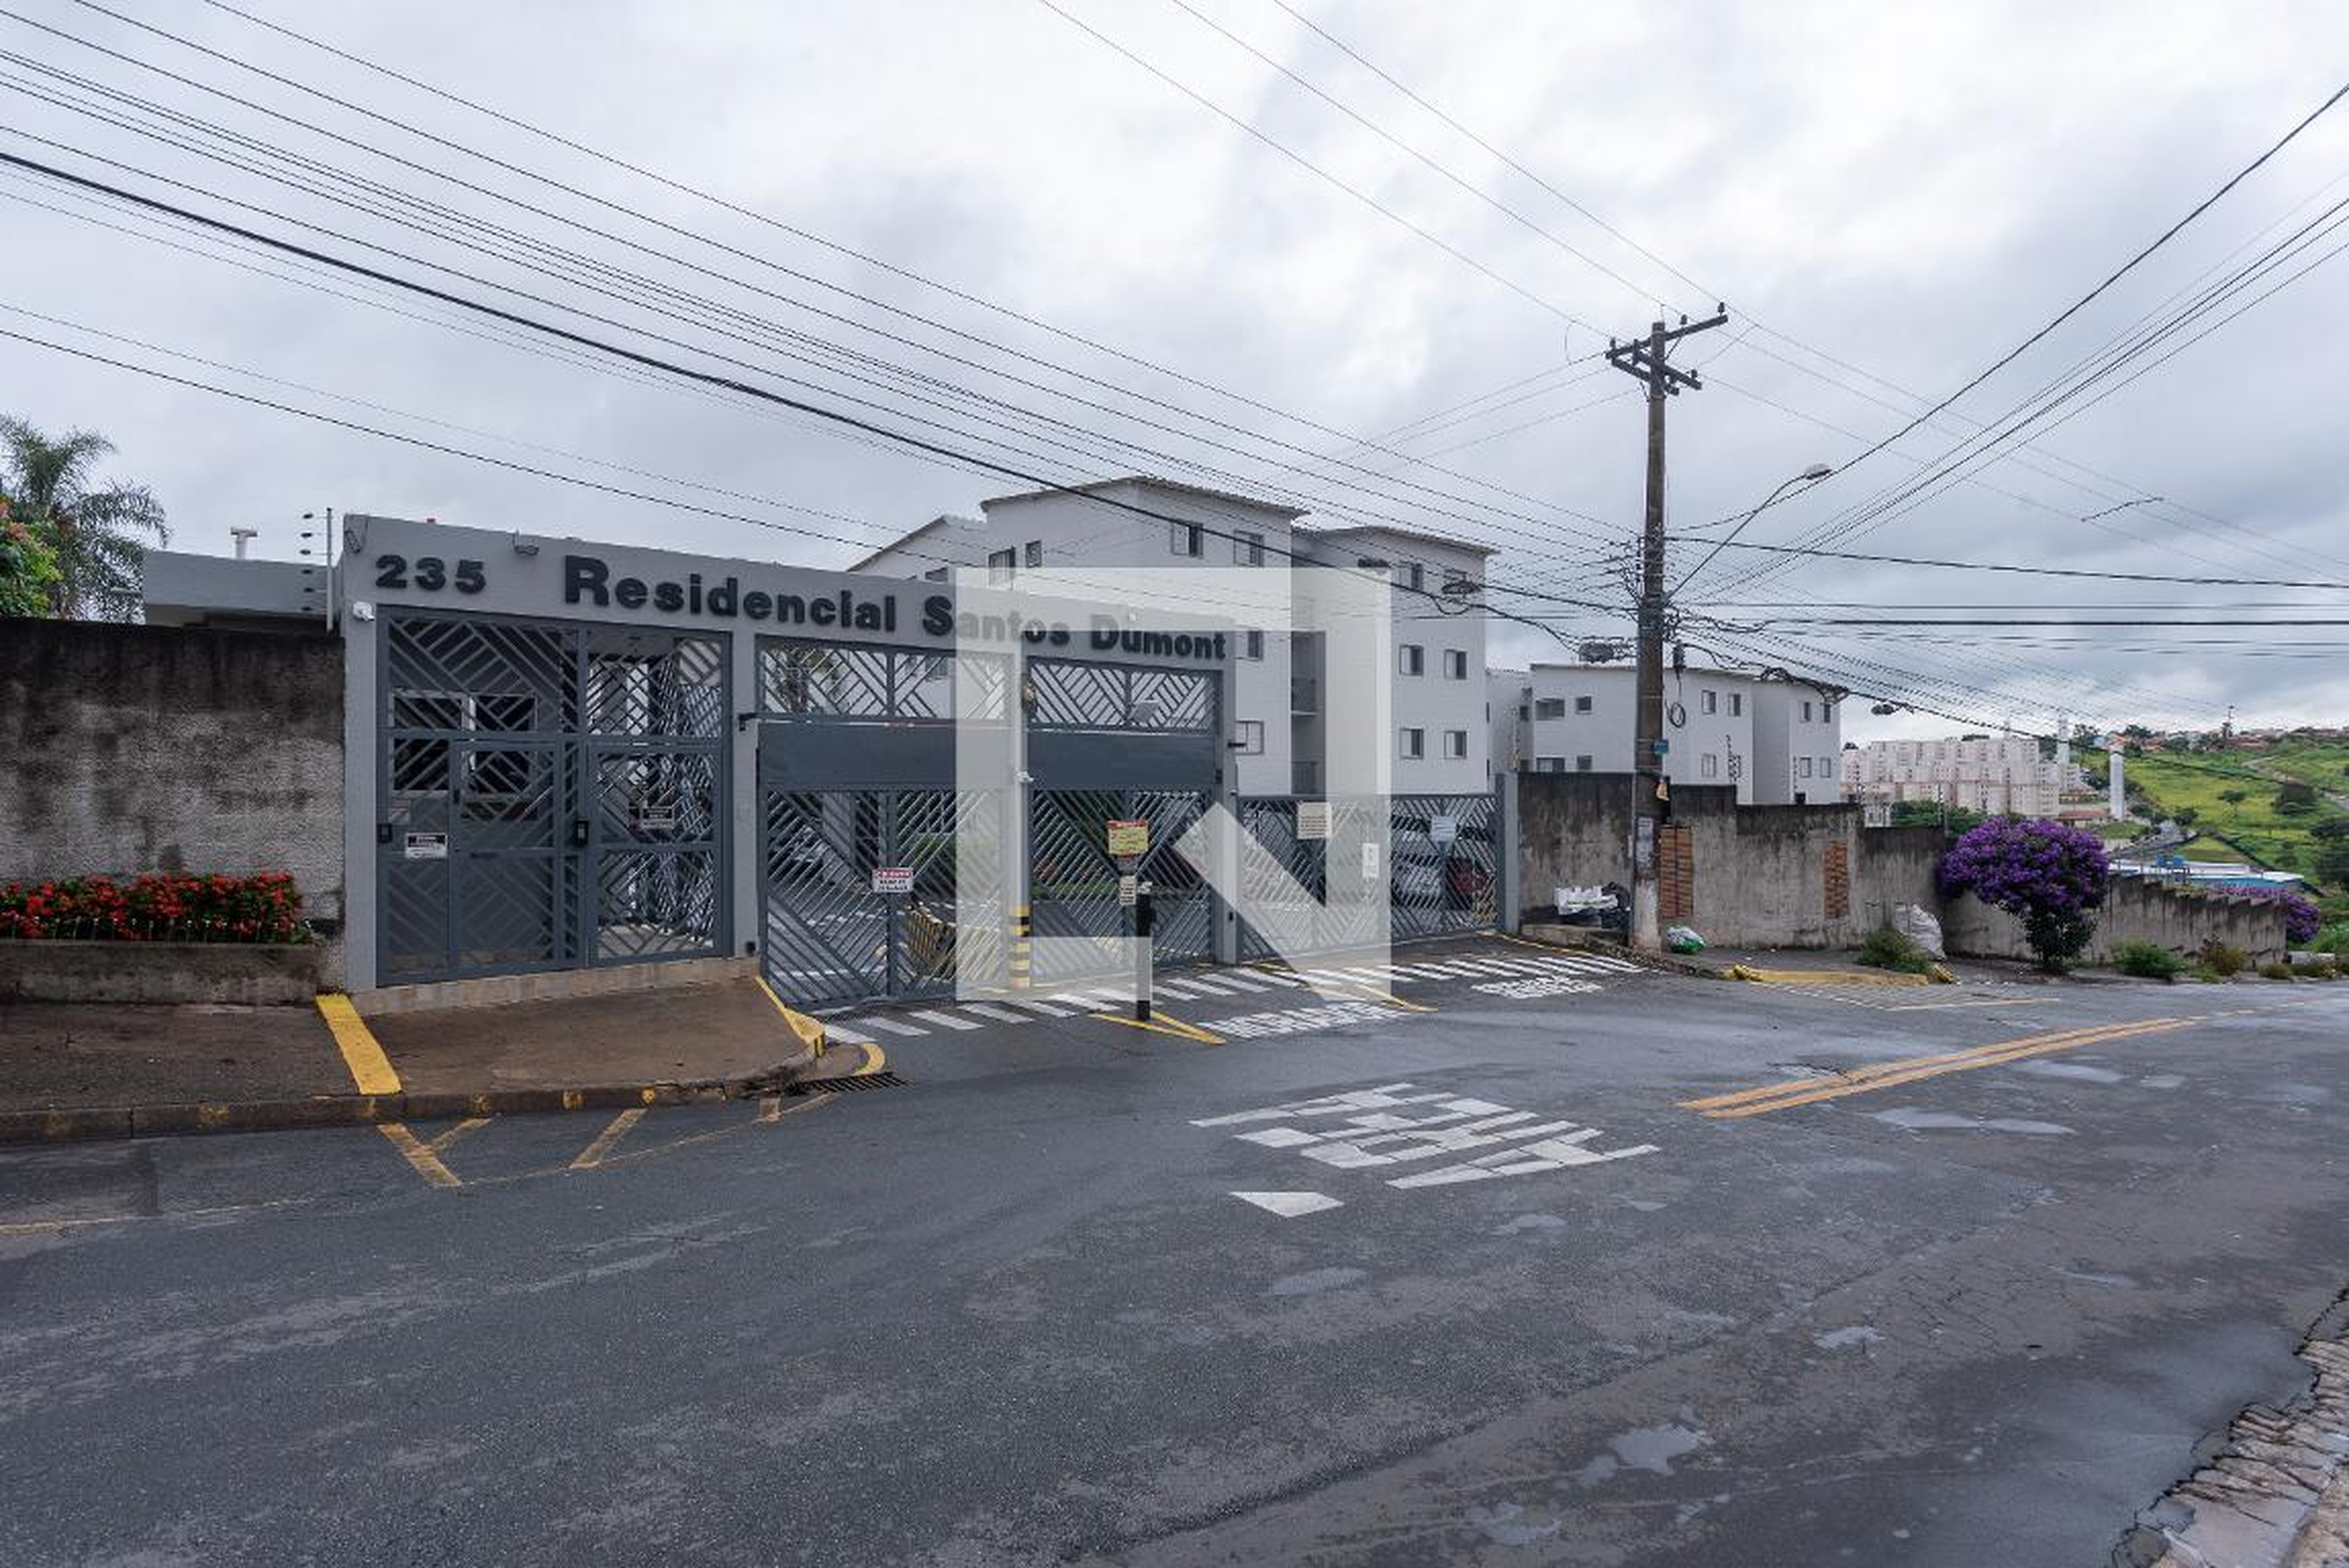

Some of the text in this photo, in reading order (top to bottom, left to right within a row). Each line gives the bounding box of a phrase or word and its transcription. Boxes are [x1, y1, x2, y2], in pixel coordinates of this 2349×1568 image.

[375, 554, 487, 594] 235
[565, 555, 1226, 660] Residencial Santos Dumont
